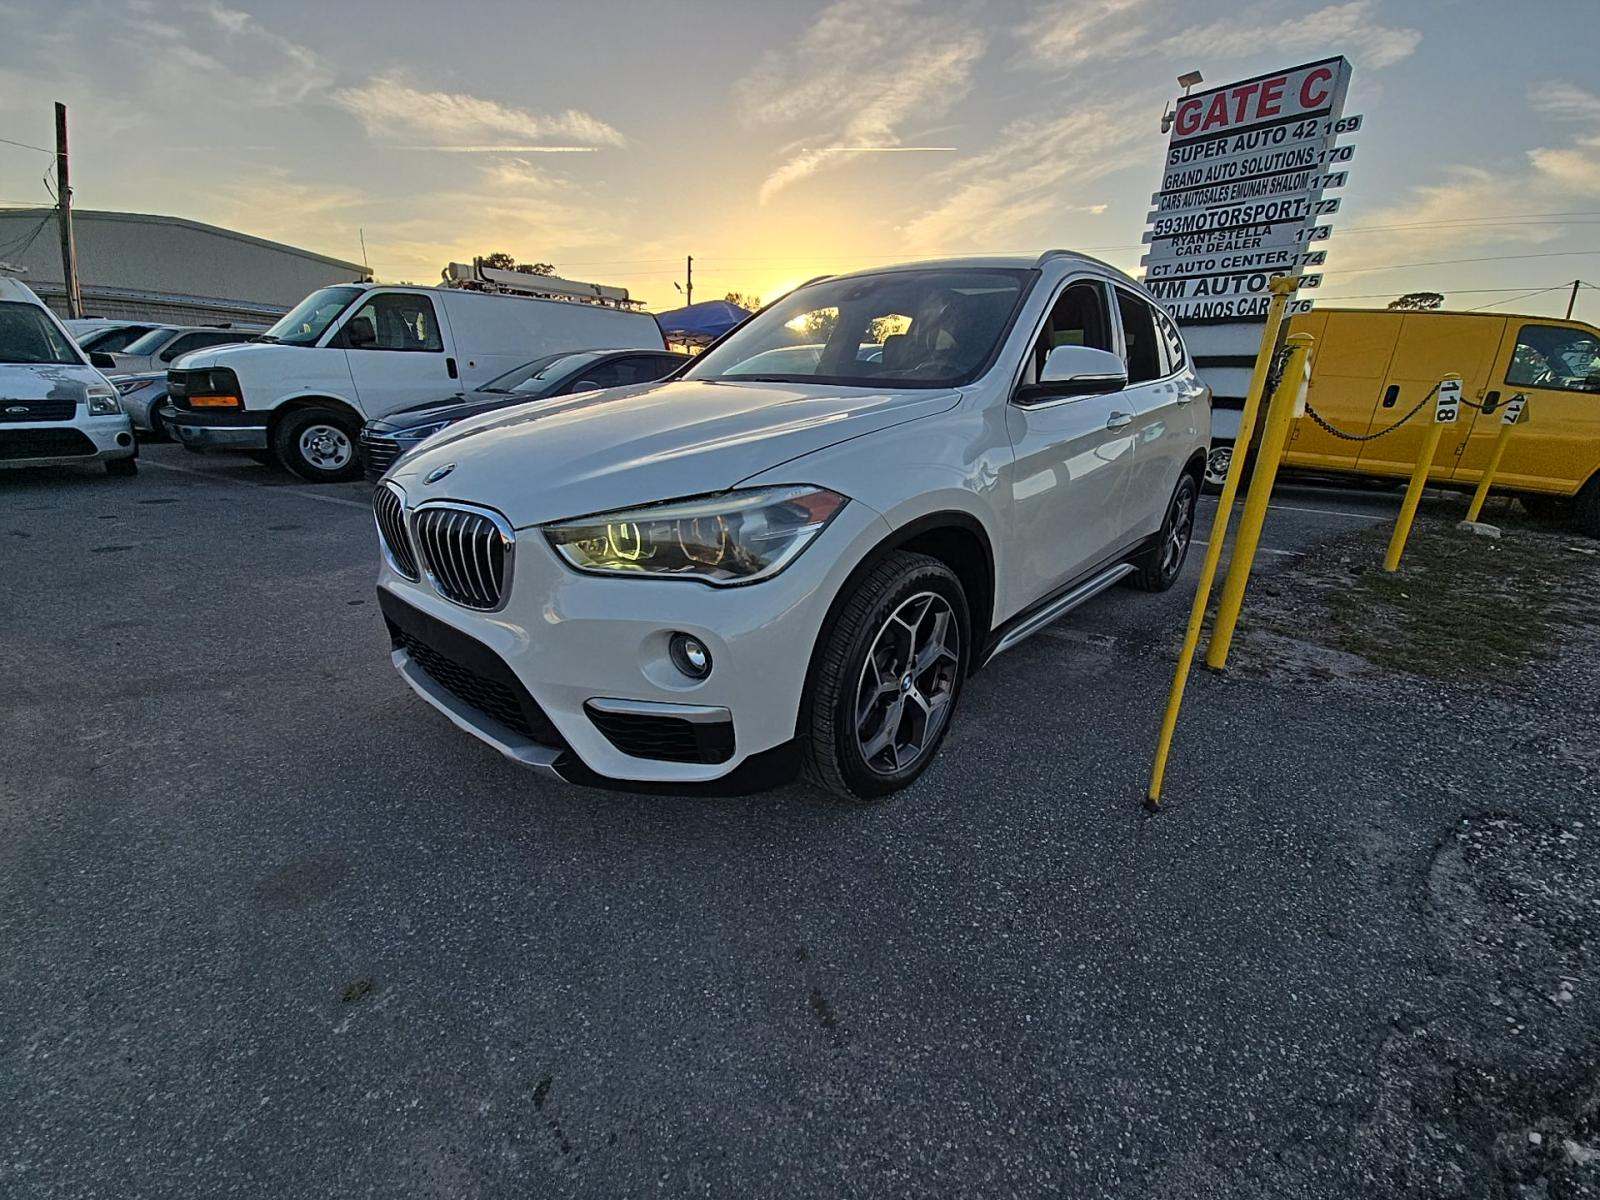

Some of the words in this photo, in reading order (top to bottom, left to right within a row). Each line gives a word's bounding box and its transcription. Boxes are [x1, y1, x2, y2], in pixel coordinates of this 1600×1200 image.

[1174, 77, 1287, 136] GATE
[1299, 68, 1332, 108] C
[1323, 116, 1359, 135] 169
[1170, 140, 1227, 165] SUPER
[1232, 129, 1285, 153] AUTO
[1292, 121, 1316, 139] 42
[1316, 148, 1352, 164] 170
[1165, 170, 1203, 190] GRAND
[1205, 163, 1237, 183] AUTO
[1241, 147, 1315, 173] SOLUTIONS
[1161, 194, 1181, 211] CARS
[1182, 187, 1229, 207] AUTOSALES
[1230, 179, 1268, 198] EMUNAH
[1270, 172, 1308, 192] SHALOM
[1310, 175, 1343, 189] 171
[1154, 198, 1306, 235] 593MOTORSPORT
[1302, 201, 1337, 216] 172
[1295, 228, 1329, 242] 173
[1175, 243, 1203, 256] CAR
[1207, 237, 1262, 252] DEALER
[1174, 258, 1216, 273] AUTO
[1220, 250, 1287, 269] CENTER
[1290, 253, 1323, 265] 174
[1147, 279, 1186, 299] WM
[1295, 276, 1319, 289] 75
[1166, 301, 1233, 319] OLLANOS
[1285, 301, 1311, 313] 76
[1437, 381, 1459, 421] 118
